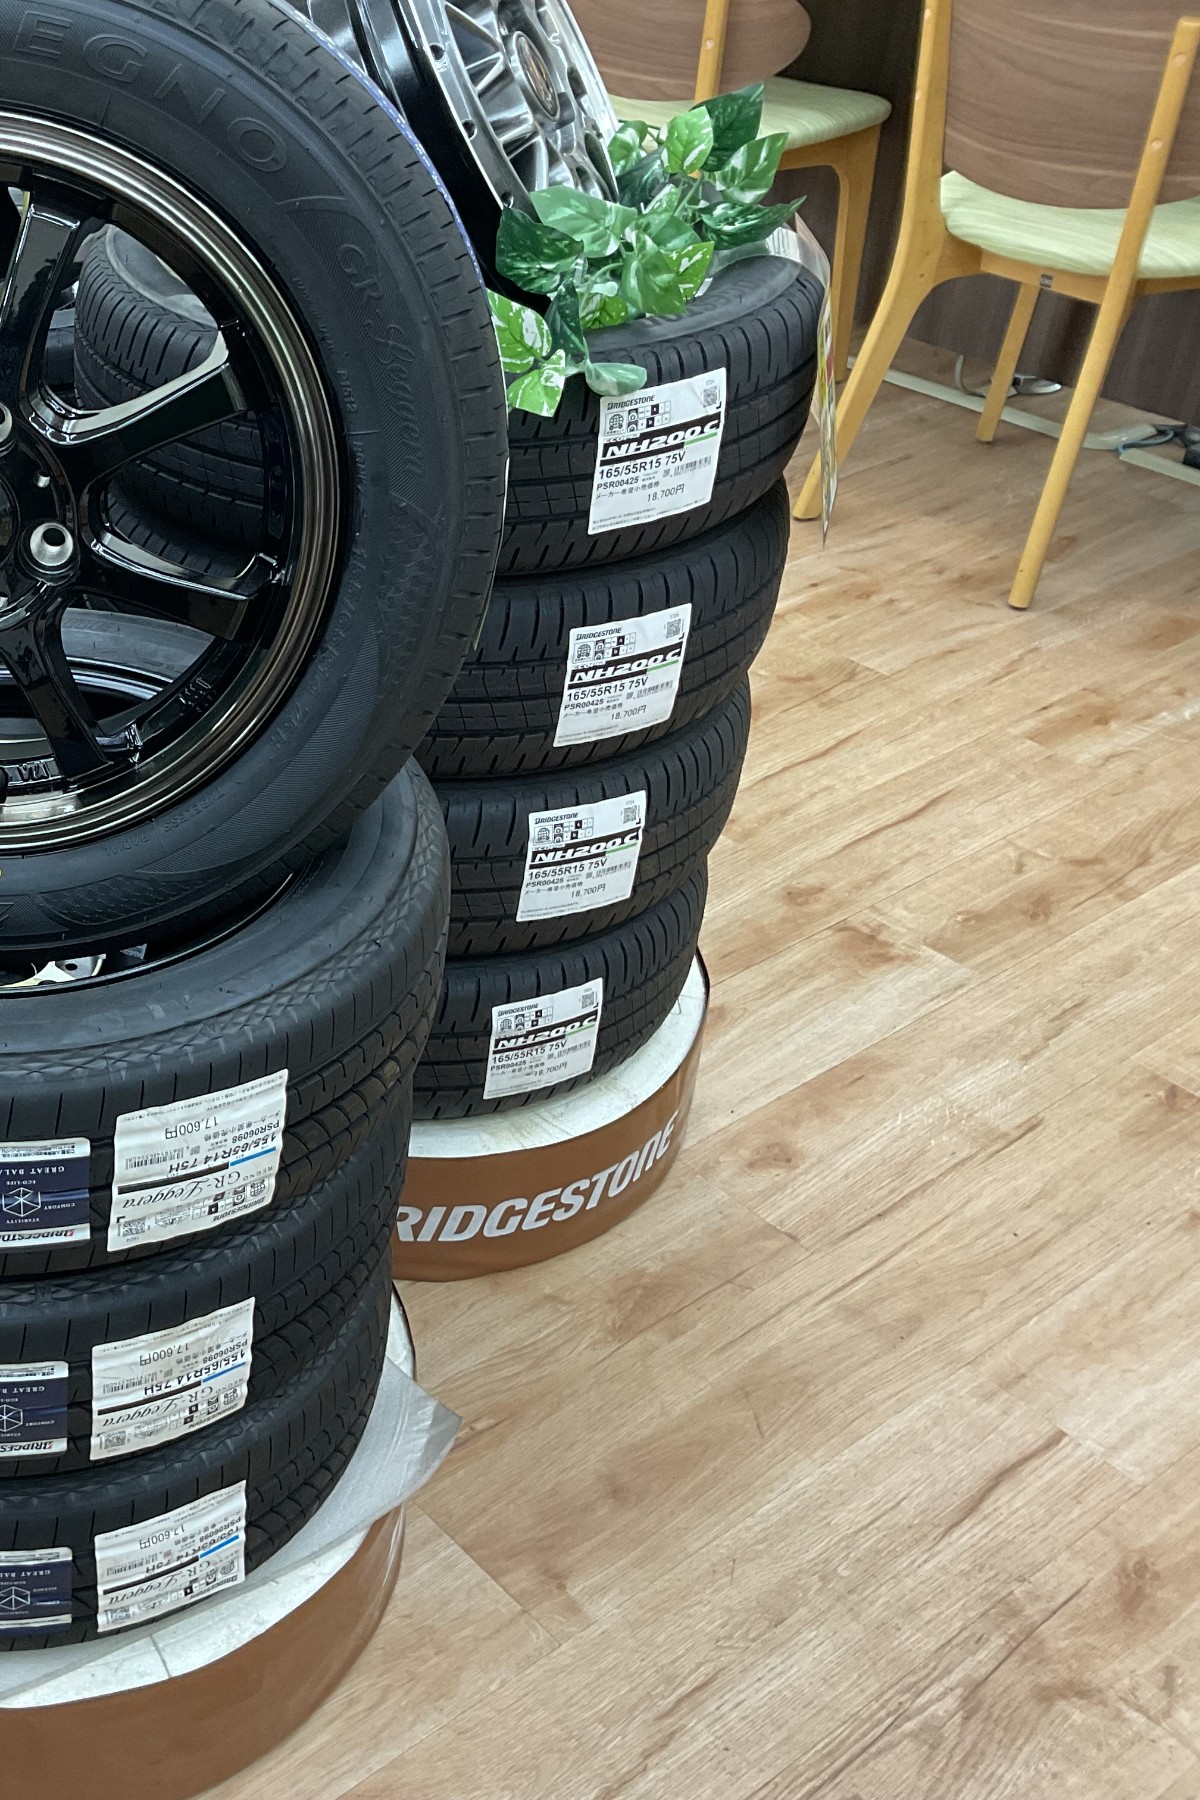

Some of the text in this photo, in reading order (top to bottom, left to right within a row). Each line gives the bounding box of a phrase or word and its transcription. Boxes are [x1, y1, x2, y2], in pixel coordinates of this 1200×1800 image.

[607, 395, 655, 410] BRIDGESTONE
[599, 456, 661, 480] 165/55R15
[665, 451, 686, 465] 75V
[597, 476, 639, 491] PSR00425
[576, 628, 622, 640] BRIDGESTONE
[567, 677, 648, 702] 165/55R15 75V
[564, 699, 604, 710] PSR00425
[535, 813, 578, 824] BRIDGESTONE
[102, 833, 149, 858] RADIAL
[529, 858, 608, 880] 165/55R15 75V
[526, 878, 564, 888] PSR00425
[498, 1003, 539, 1016] BRIDGESTONE
[492, 1040, 567, 1064] 165/55R15 75V
[203, 1110, 280, 1141] メーカー希望小売価格
[232, 1120, 280, 1143] PSR06098
[203, 1131, 276, 1164] 155/65R14
[31, 1166, 64, 1176] GREAT
[168, 1157, 198, 1173] 75H
[243, 1166, 273, 1181] REGNO
[396, 1112, 677, 1242] RIDGESTONE
[203, 1339, 248, 1364] PSR06098
[177, 1349, 246, 1385] 155/65R14
[12, 1386, 45, 1394] GREAT
[144, 1380, 171, 1395] 75H
[199, 1516, 241, 1543] PSR06098
[21, 1569, 51, 1577] GREAT
